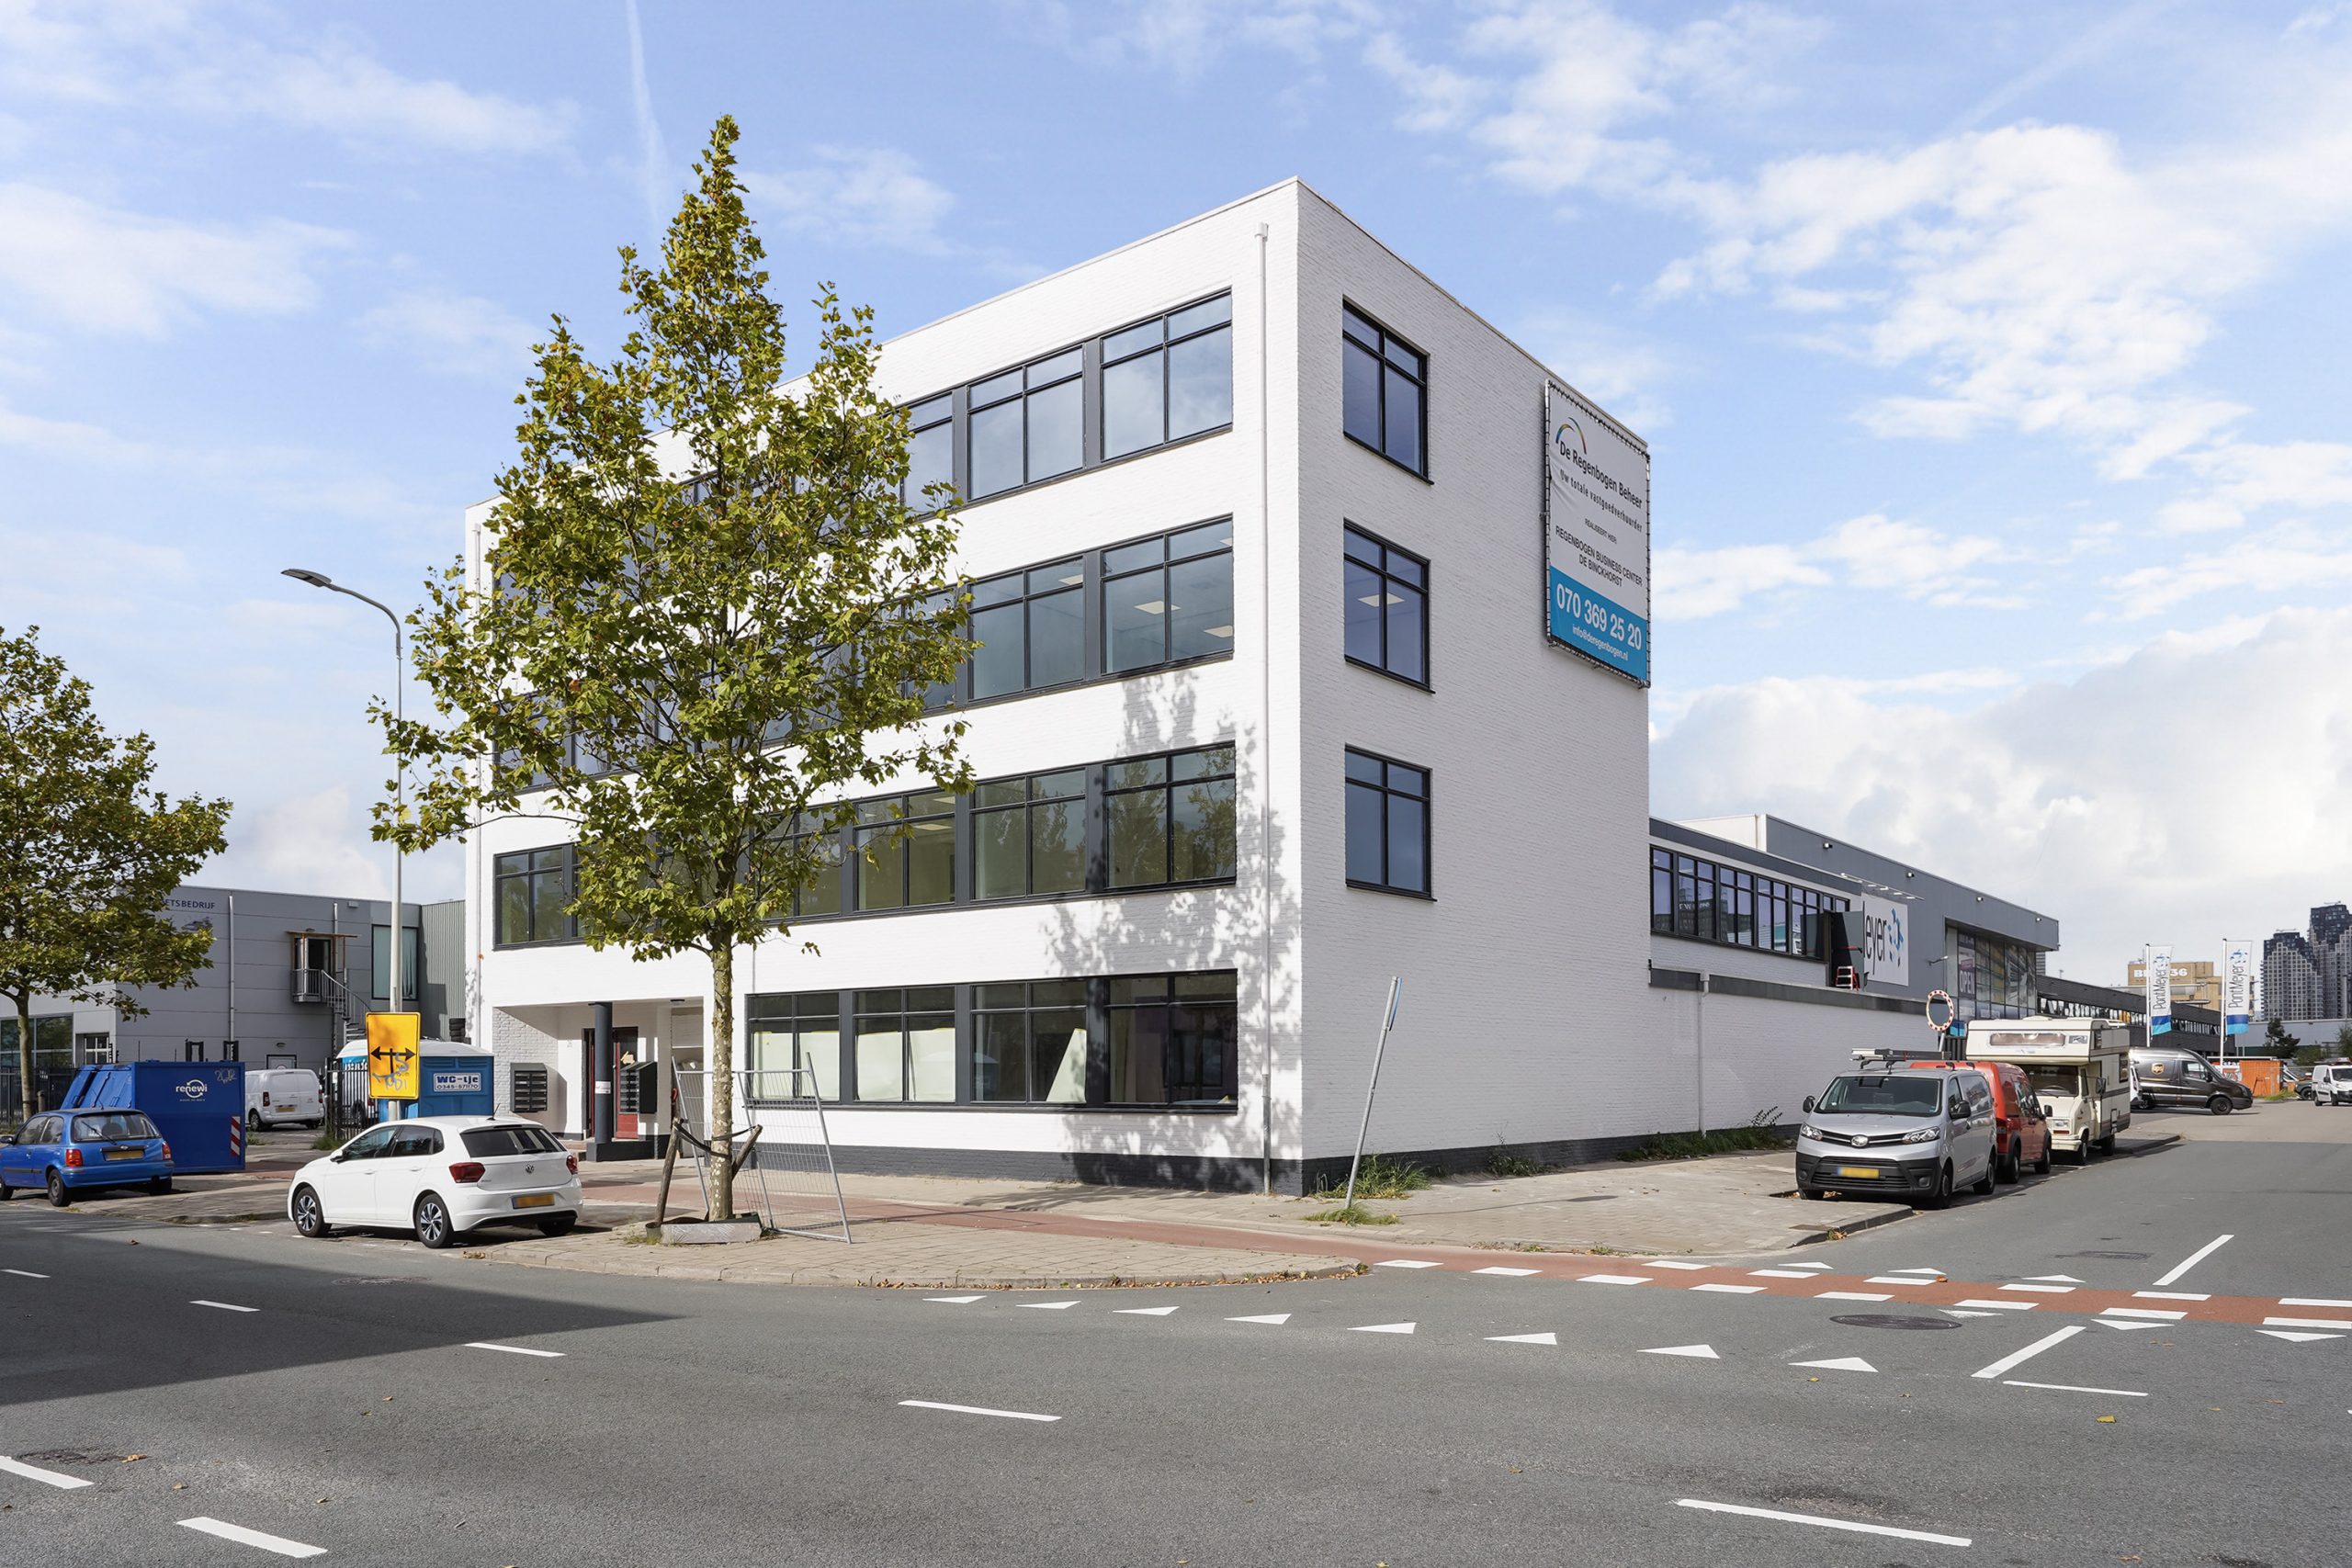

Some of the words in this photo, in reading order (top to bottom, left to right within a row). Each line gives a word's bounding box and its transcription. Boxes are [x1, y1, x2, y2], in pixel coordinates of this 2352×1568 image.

[1559, 441, 1571, 460] De
[1572, 449, 1617, 492] Regenbogen
[1619, 482, 1643, 509] Beheer
[1560, 468, 1569, 483] Uw
[1570, 477, 1589, 497] totale
[1589, 491, 1643, 532] vastgoedverhuurder
[1555, 525, 1595, 558] REGENBOGEN
[1595, 550, 1623, 575] BUSINESS
[1622, 567, 1643, 588] CENTER
[1578, 554, 1588, 568] DE
[1588, 559, 1623, 588] BINCKHORST
[1556, 582, 1581, 619] 070
[1584, 599, 1608, 633] 369
[1610, 613, 1625, 642] 25
[1627, 623, 1643, 651] 20
[1572, 624, 1629, 661] info@deregenbogen.nl
[1862, 900, 1887, 976] eyer
[1959, 969, 1975, 994] OPEN
[2152, 968, 2169, 1010] PontMeyer
[2227, 964, 2248, 1009] PontMeyer
[175, 1083, 208, 1092] renewi
